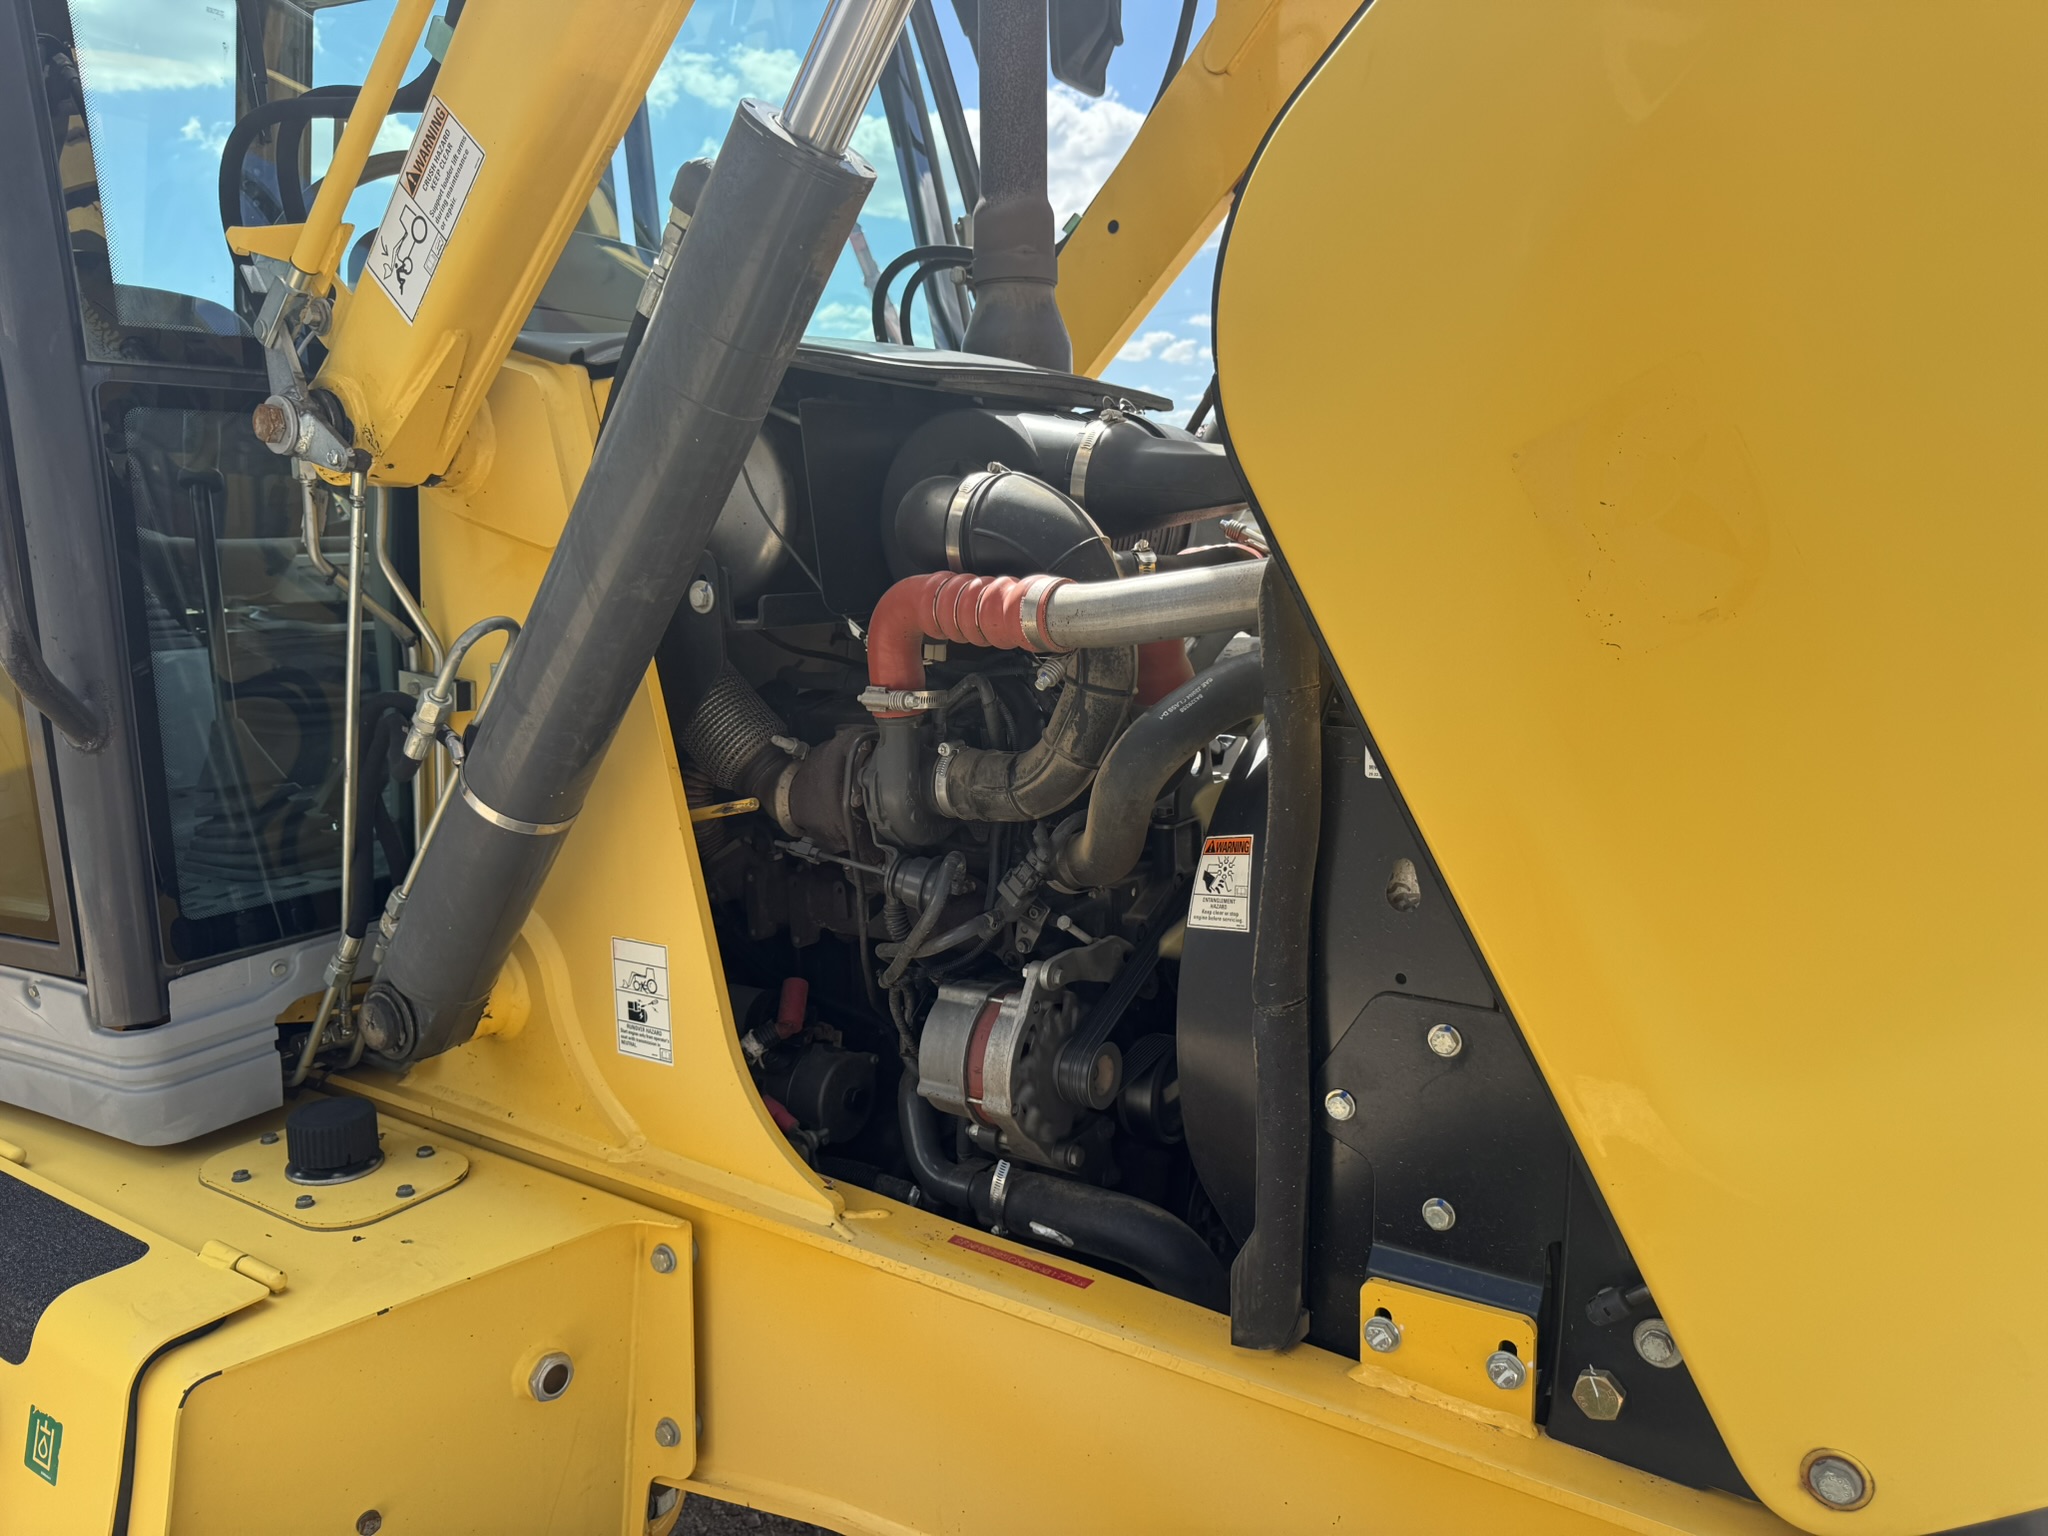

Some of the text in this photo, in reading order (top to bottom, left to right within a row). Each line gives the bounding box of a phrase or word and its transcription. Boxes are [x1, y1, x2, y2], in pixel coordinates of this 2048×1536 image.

[413, 106, 446, 174] WARNING
[422, 128, 451, 192] CRUSH HAZARD
[430, 142, 453, 192] KEEP CLEAR
[429, 135, 467, 218] Support loader lift arms
[435, 148, 470, 225] during maintenance
[440, 222, 447, 231] or
[1216, 840, 1250, 853] WARNING
